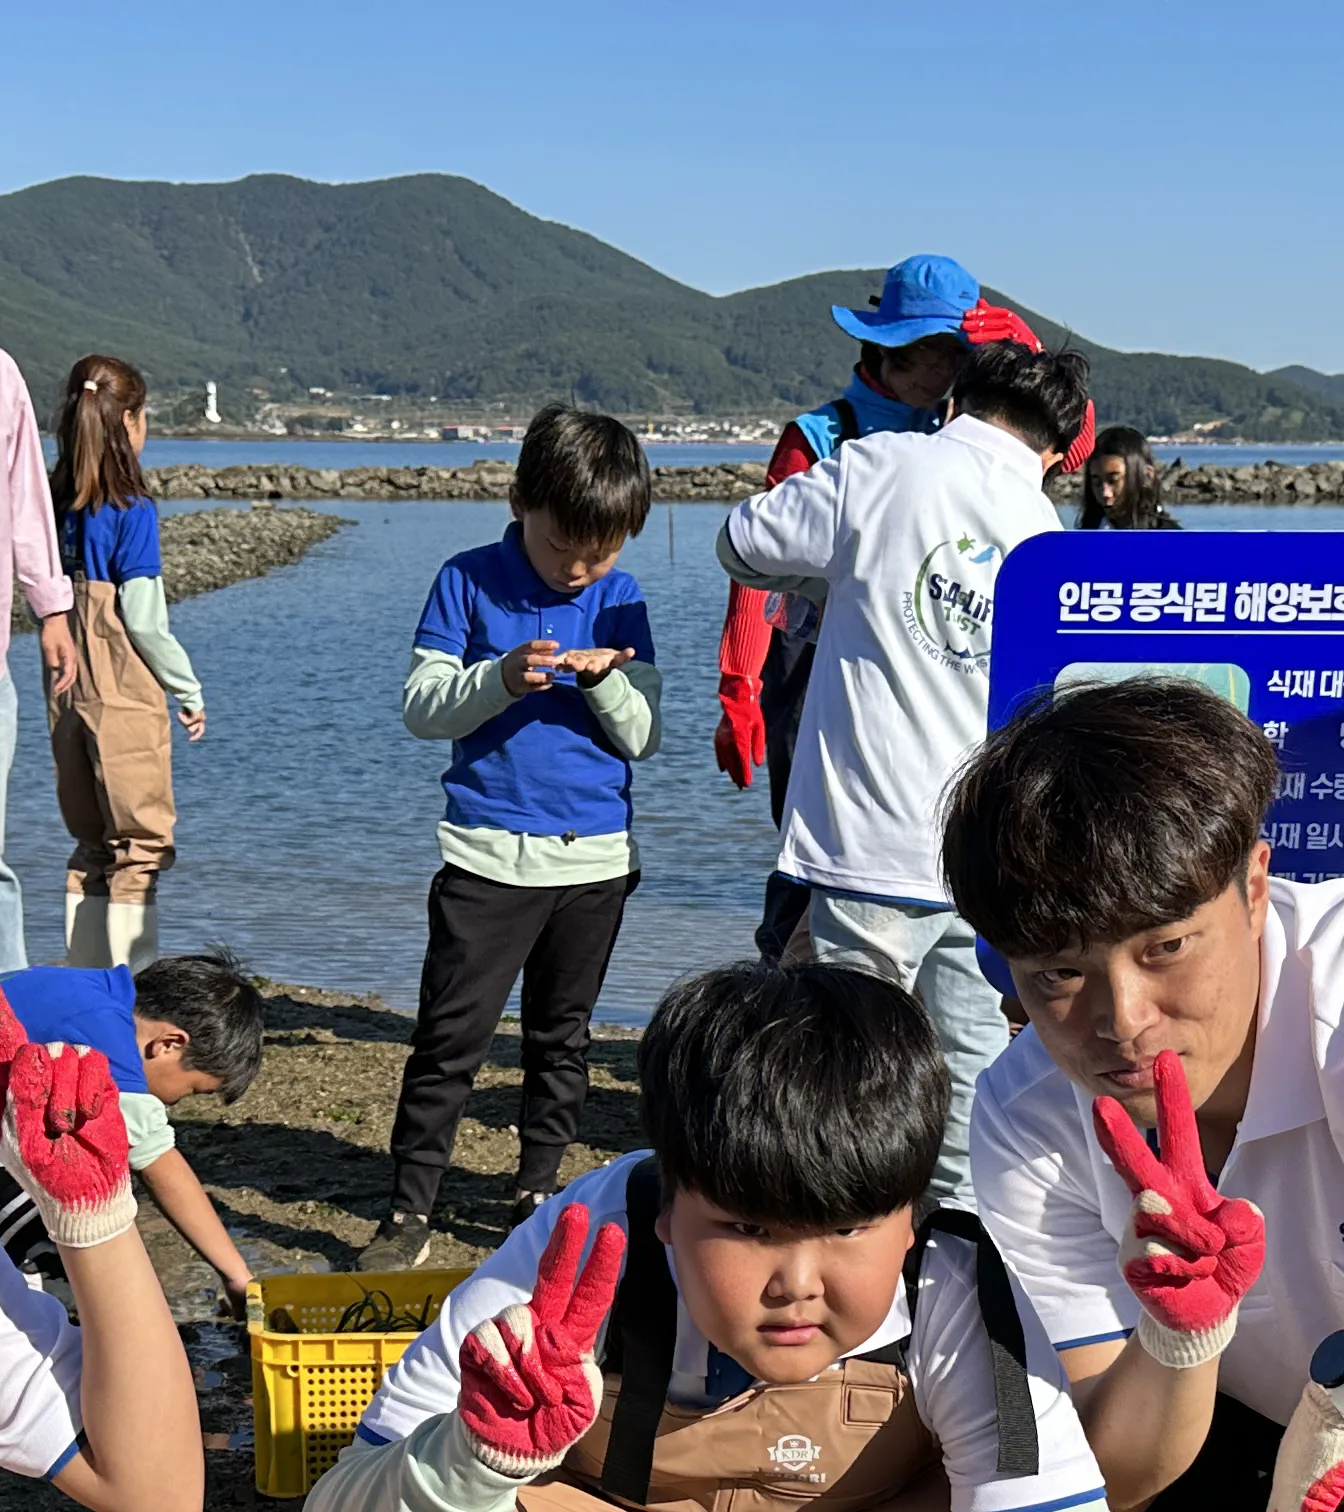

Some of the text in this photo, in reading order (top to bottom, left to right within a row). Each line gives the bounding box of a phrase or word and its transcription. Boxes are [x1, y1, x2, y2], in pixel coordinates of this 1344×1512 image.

[1058, 581, 1124, 623] 인공
[1129, 582, 1227, 623] 증식된
[903, 591, 961, 673] PROTECTING THE
[1267, 669, 1315, 698] 식재
[781, 1449, 809, 1460] KDR
